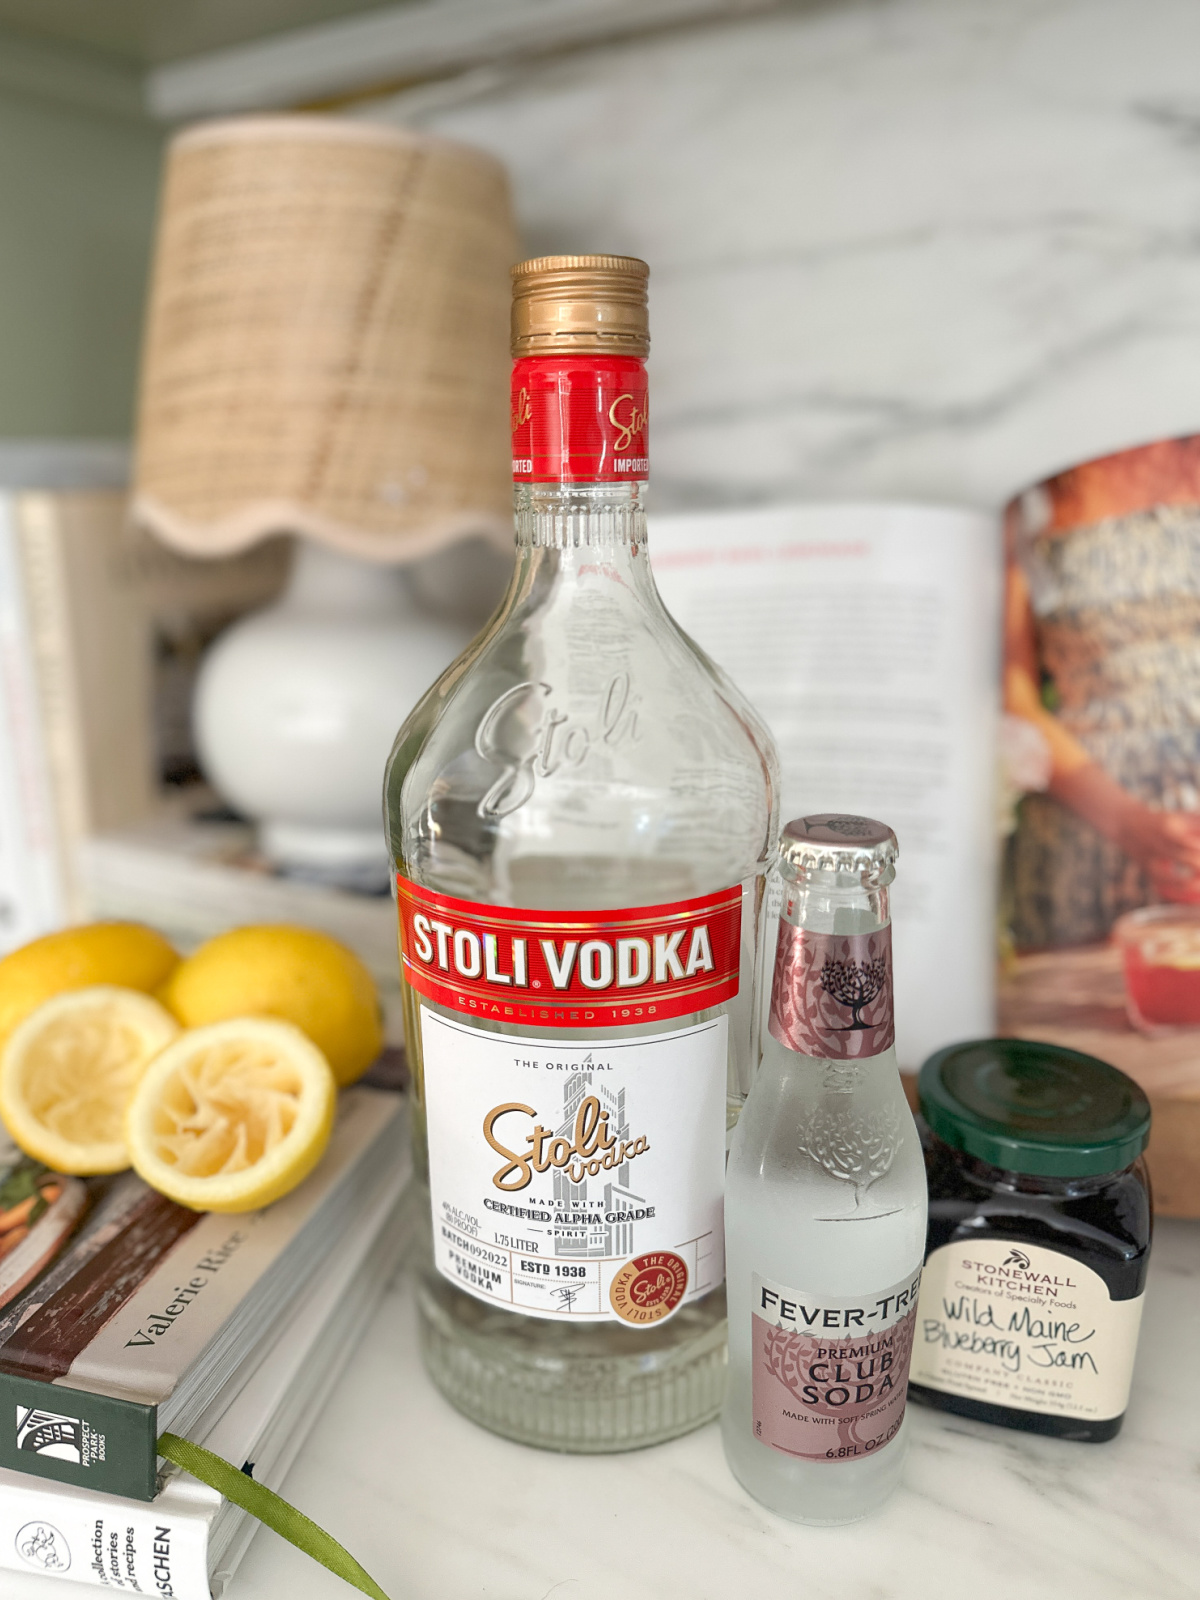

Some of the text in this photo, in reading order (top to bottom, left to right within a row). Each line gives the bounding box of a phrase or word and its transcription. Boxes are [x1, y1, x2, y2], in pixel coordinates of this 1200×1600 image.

[413, 912, 715, 991] STOLI VODKA
[458, 996, 657, 1020] ESTABLISHED 1938
[514, 1058, 614, 1072] THE ORIGINAL
[482, 1095, 618, 1192] Stoli
[563, 1134, 651, 1184] vodka
[483, 1197, 656, 1225] CERTIFIED ALPHA GRADE
[529, 1197, 605, 1209] MADE WITH
[441, 1225, 508, 1268] BATCH 092022
[493, 1231, 540, 1254] 1.75 LITER
[546, 1229, 587, 1238] SPIRIT
[448, 1249, 502, 1285] PREMIUM
[456, 1266, 493, 1292] VODKA
[554, 1264, 587, 1278] 1938
[643, 1256, 686, 1302] THE ORIGINAL
[961, 1259, 1077, 1288] STONEWALL
[123, 1230, 246, 1349] Valerie Rice
[615, 1272, 662, 1321] STOLI VODKA
[633, 1273, 666, 1304] Stoli
[954, 1280, 1077, 1310] Creators of Specialty Foods
[977, 1274, 1059, 1298] KITCHEN
[943, 1295, 1096, 1344] Wild Maine
[818, 1335, 894, 1360] PREMIUM
[923, 1318, 1099, 1375] Blueberry Jam
[808, 1351, 894, 1383] CLUB
[802, 1373, 895, 1407] SODA
[782, 1409, 809, 1423] MADE
[812, 1416, 836, 1426] WITH
[838, 1415, 859, 1425] SOFT
[860, 1404, 887, 1421] SPRING
[81, 1418, 91, 1468] PROSPECT
[98, 1433, 106, 1462] BOOKS
[825, 1446, 861, 1459] 6.8FL
[107, 1532, 121, 1577] stories
[122, 1526, 137, 1577] recipes
